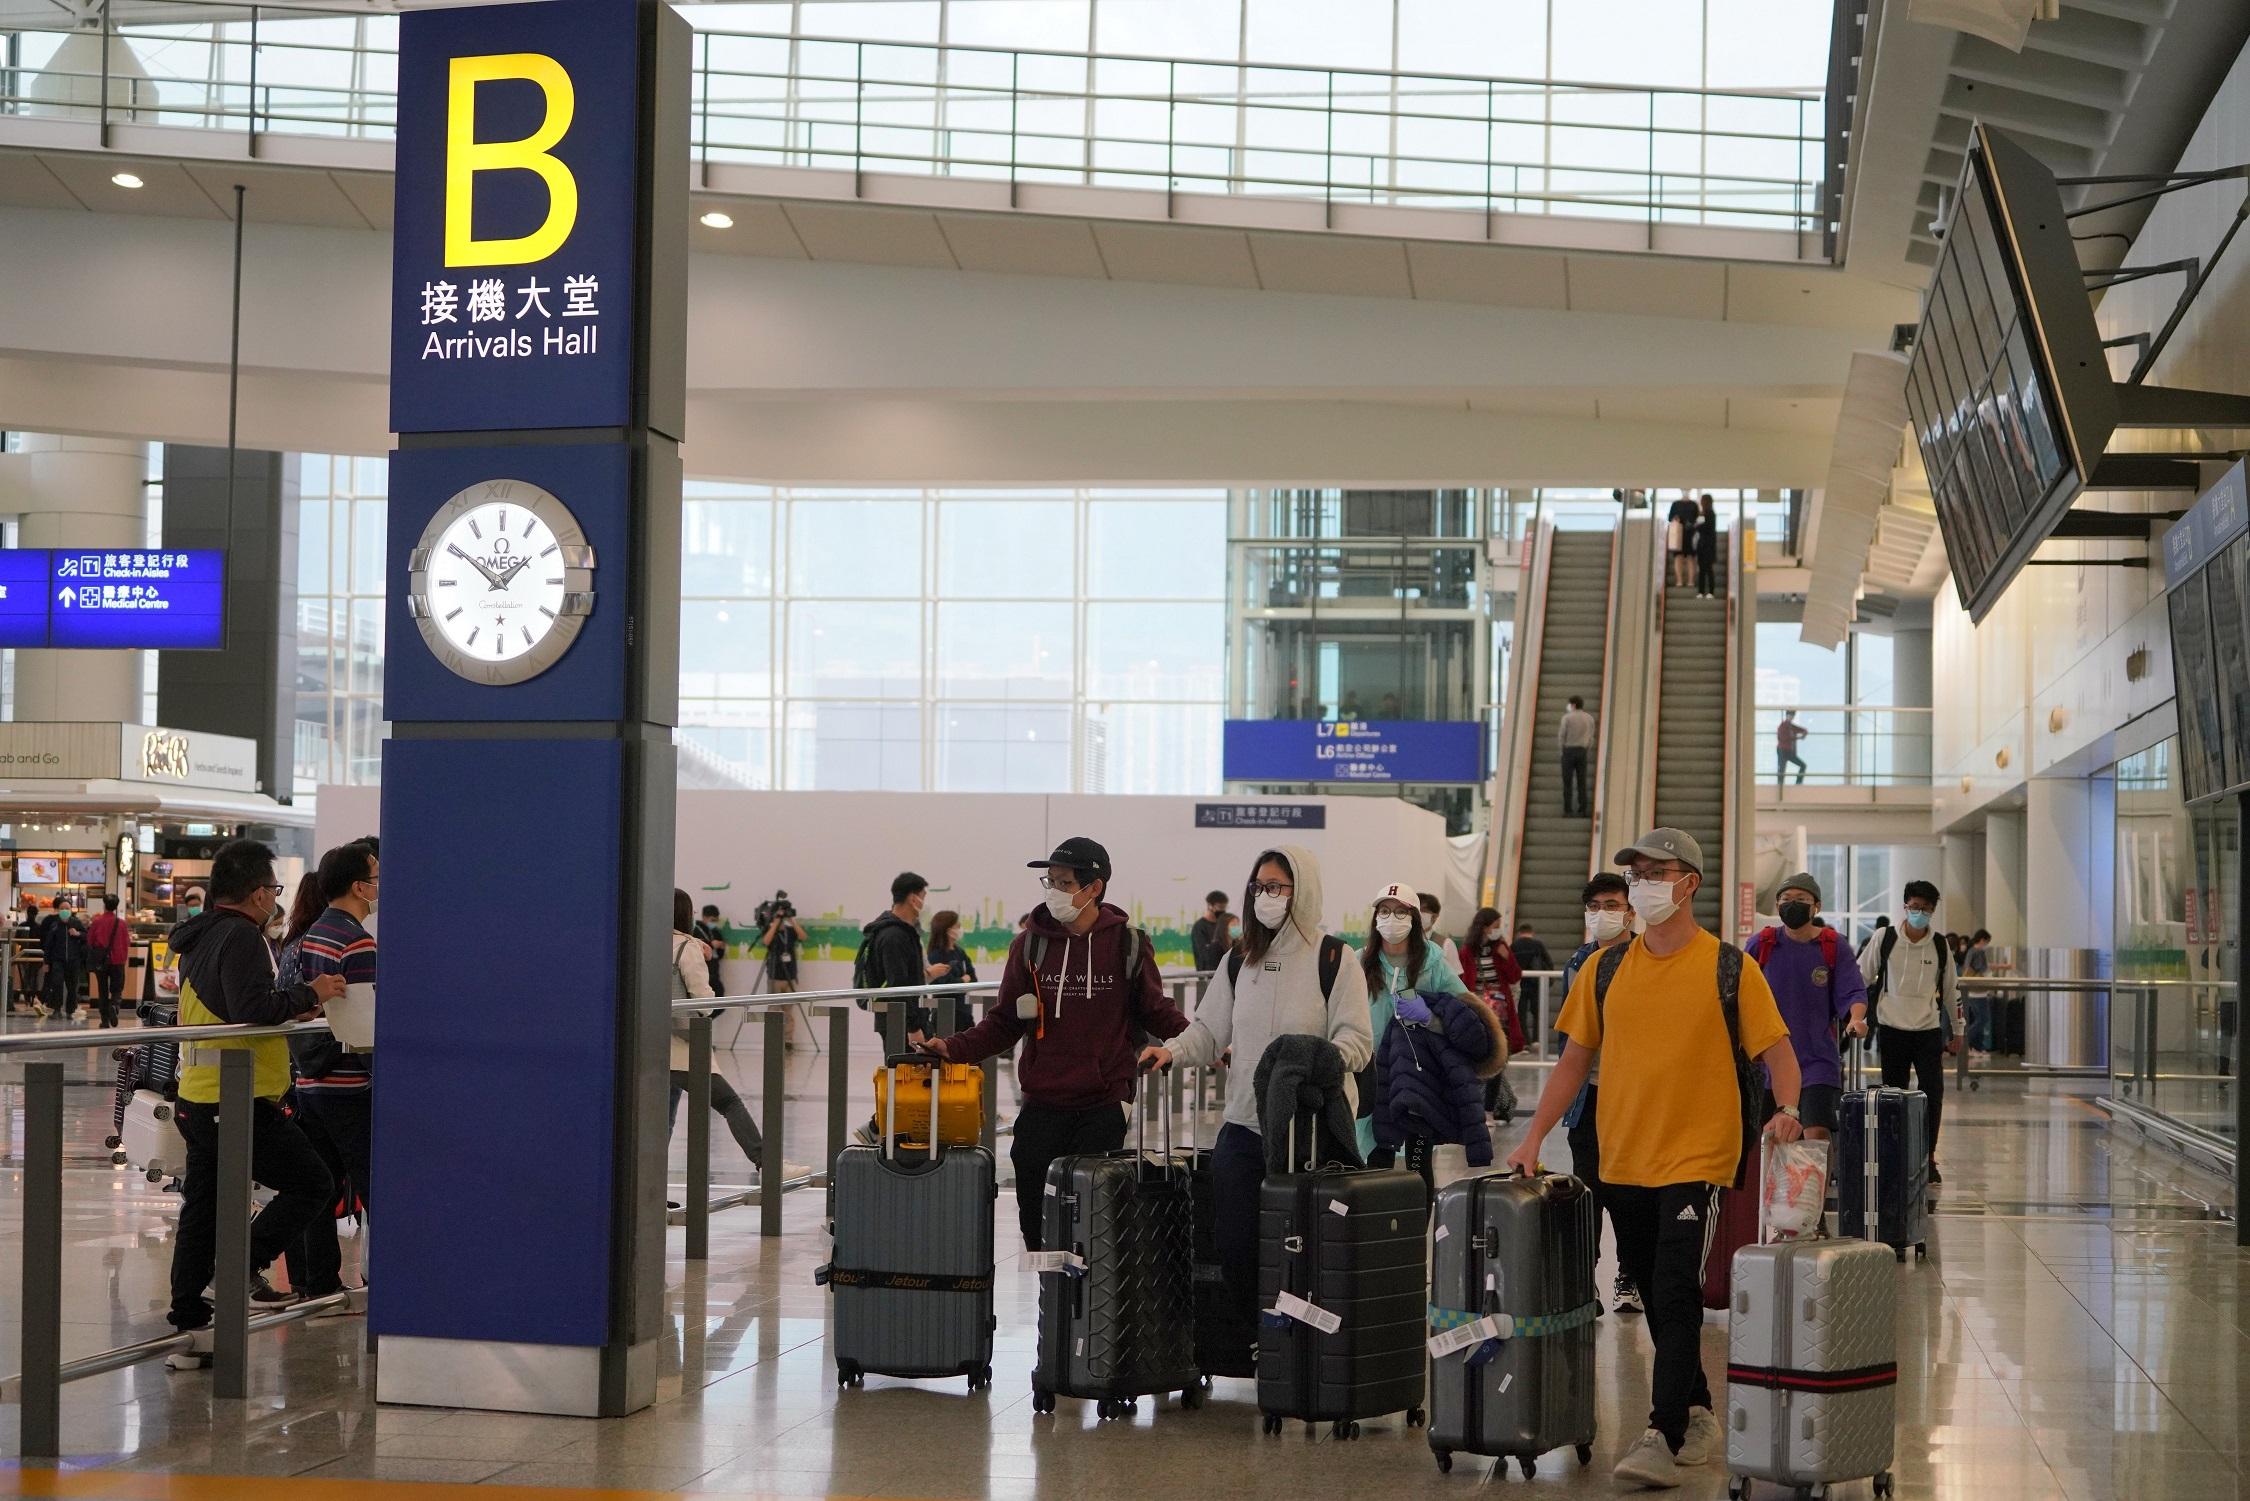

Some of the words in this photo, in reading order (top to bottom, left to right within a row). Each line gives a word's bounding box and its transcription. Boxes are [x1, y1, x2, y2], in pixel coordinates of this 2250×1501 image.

[445, 53, 578, 267] B
[421, 274, 599, 325] 接機大堂
[422, 329, 532, 360] Arrivals
[543, 325, 597, 355] Hall
[84, 560, 98, 573] T1
[103, 554, 189, 568] 旅客登記行段
[103, 568, 142, 578] Check-in
[142, 567, 170, 578] Aisles
[102, 598, 137, 609] Medical
[138, 598, 169, 609] Centre
[1316, 723, 1334, 737] L7
[1316, 744, 1335, 759] L6
[0, 753, 14, 764] ab
[17, 753, 40, 764] and
[43, 752, 60, 765] Go
[1388, 885, 1399, 896] H
[1076, 975, 1113, 983] WLLS
[833, 1272, 858, 1284] etou
[885, 1275, 931, 1288] Jetour
